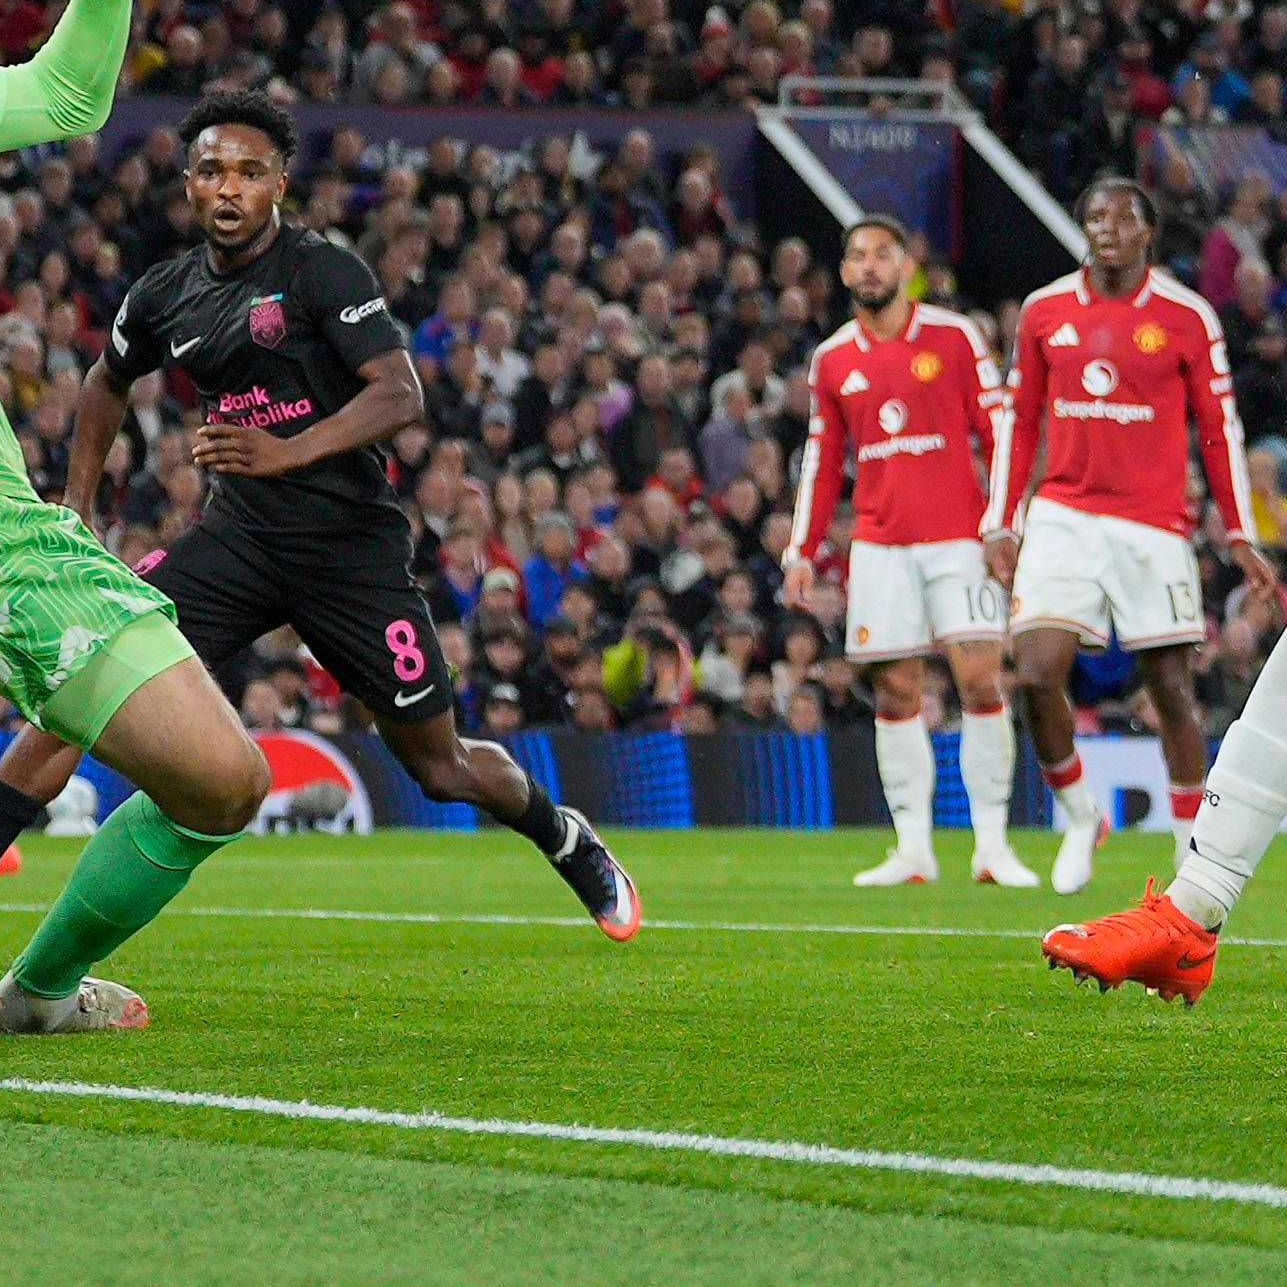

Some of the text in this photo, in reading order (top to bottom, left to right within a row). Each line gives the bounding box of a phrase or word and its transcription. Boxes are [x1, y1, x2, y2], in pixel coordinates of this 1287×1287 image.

[966, 583, 997, 623] 10
[1165, 581, 1197, 624] 13
[385, 618, 426, 682] 8
